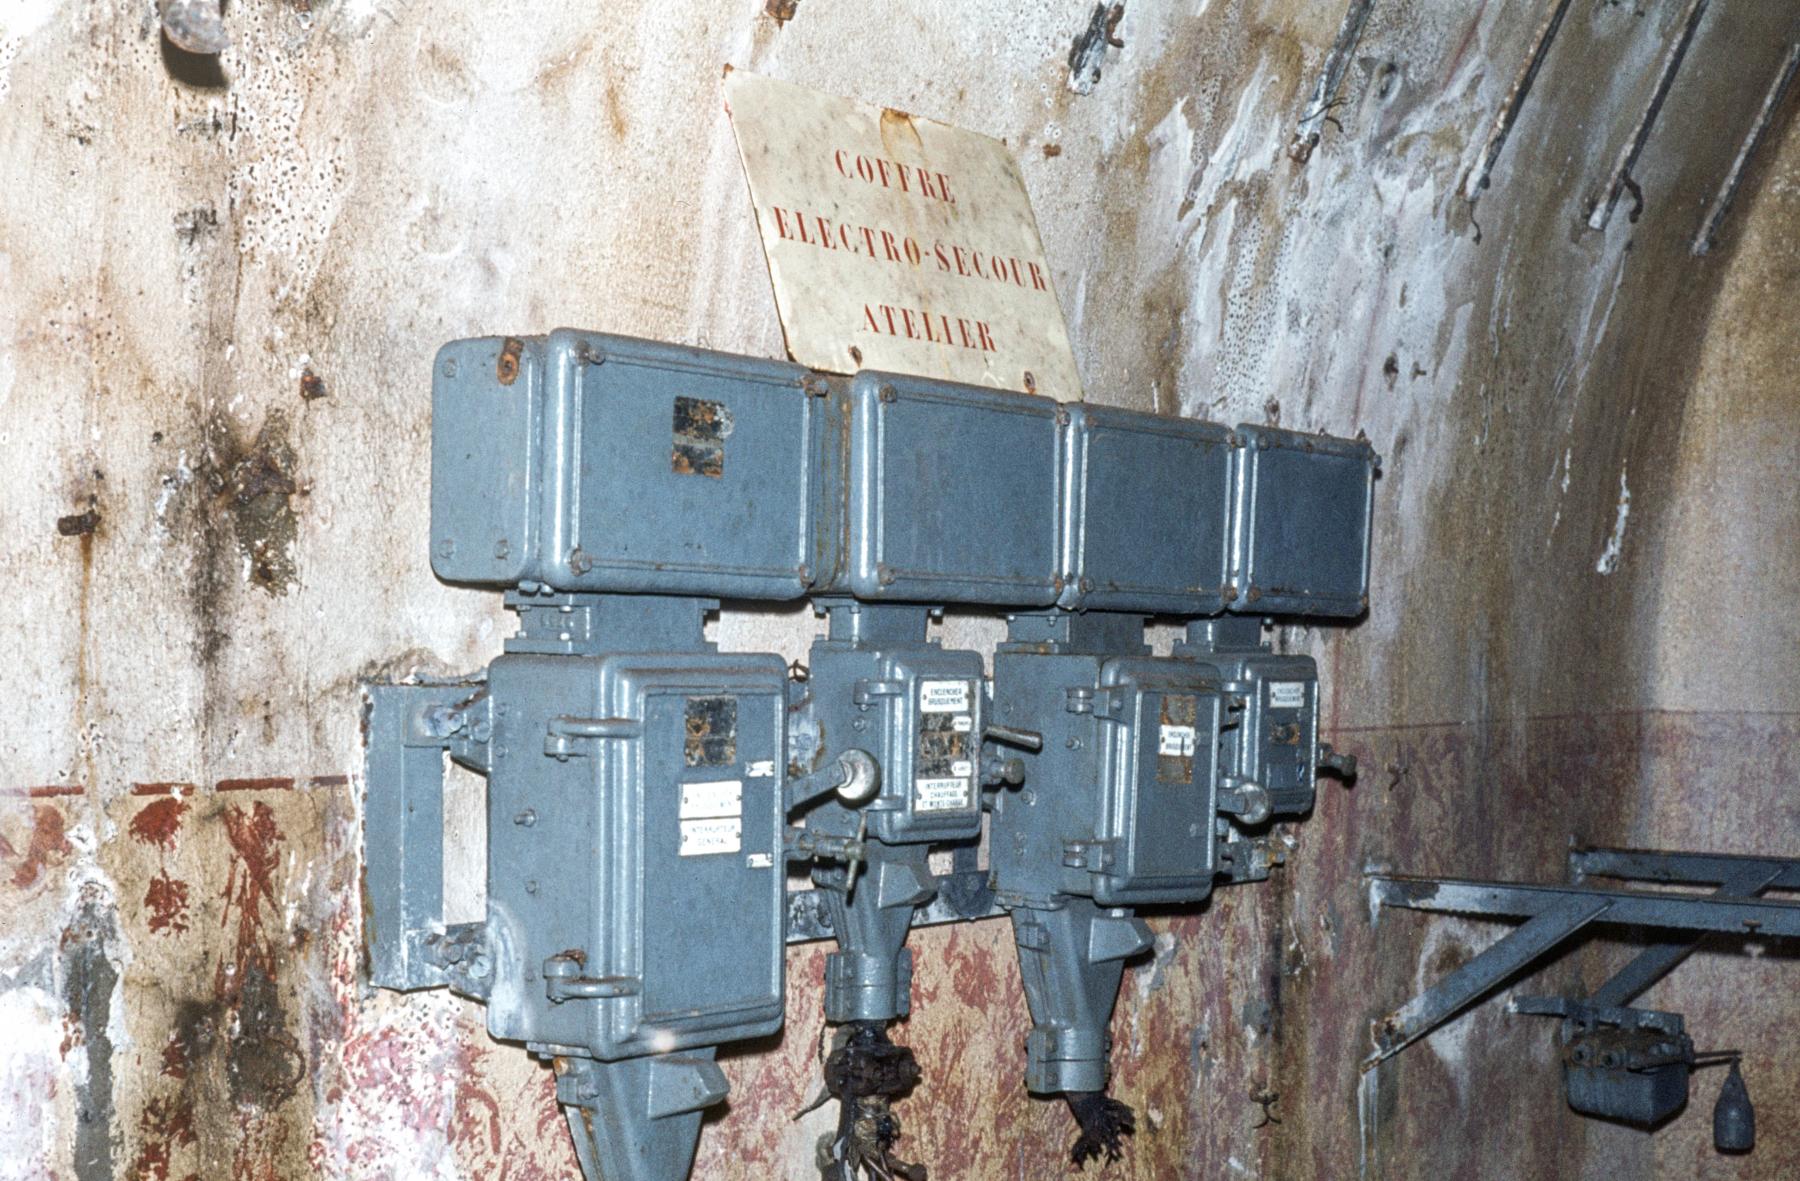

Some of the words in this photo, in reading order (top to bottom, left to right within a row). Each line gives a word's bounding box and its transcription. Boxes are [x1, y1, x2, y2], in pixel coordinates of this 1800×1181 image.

[835, 149, 956, 204] COFFRE
[773, 206, 1047, 291] ELECTRO-SECOUR
[861, 303, 997, 352] ATELIER
